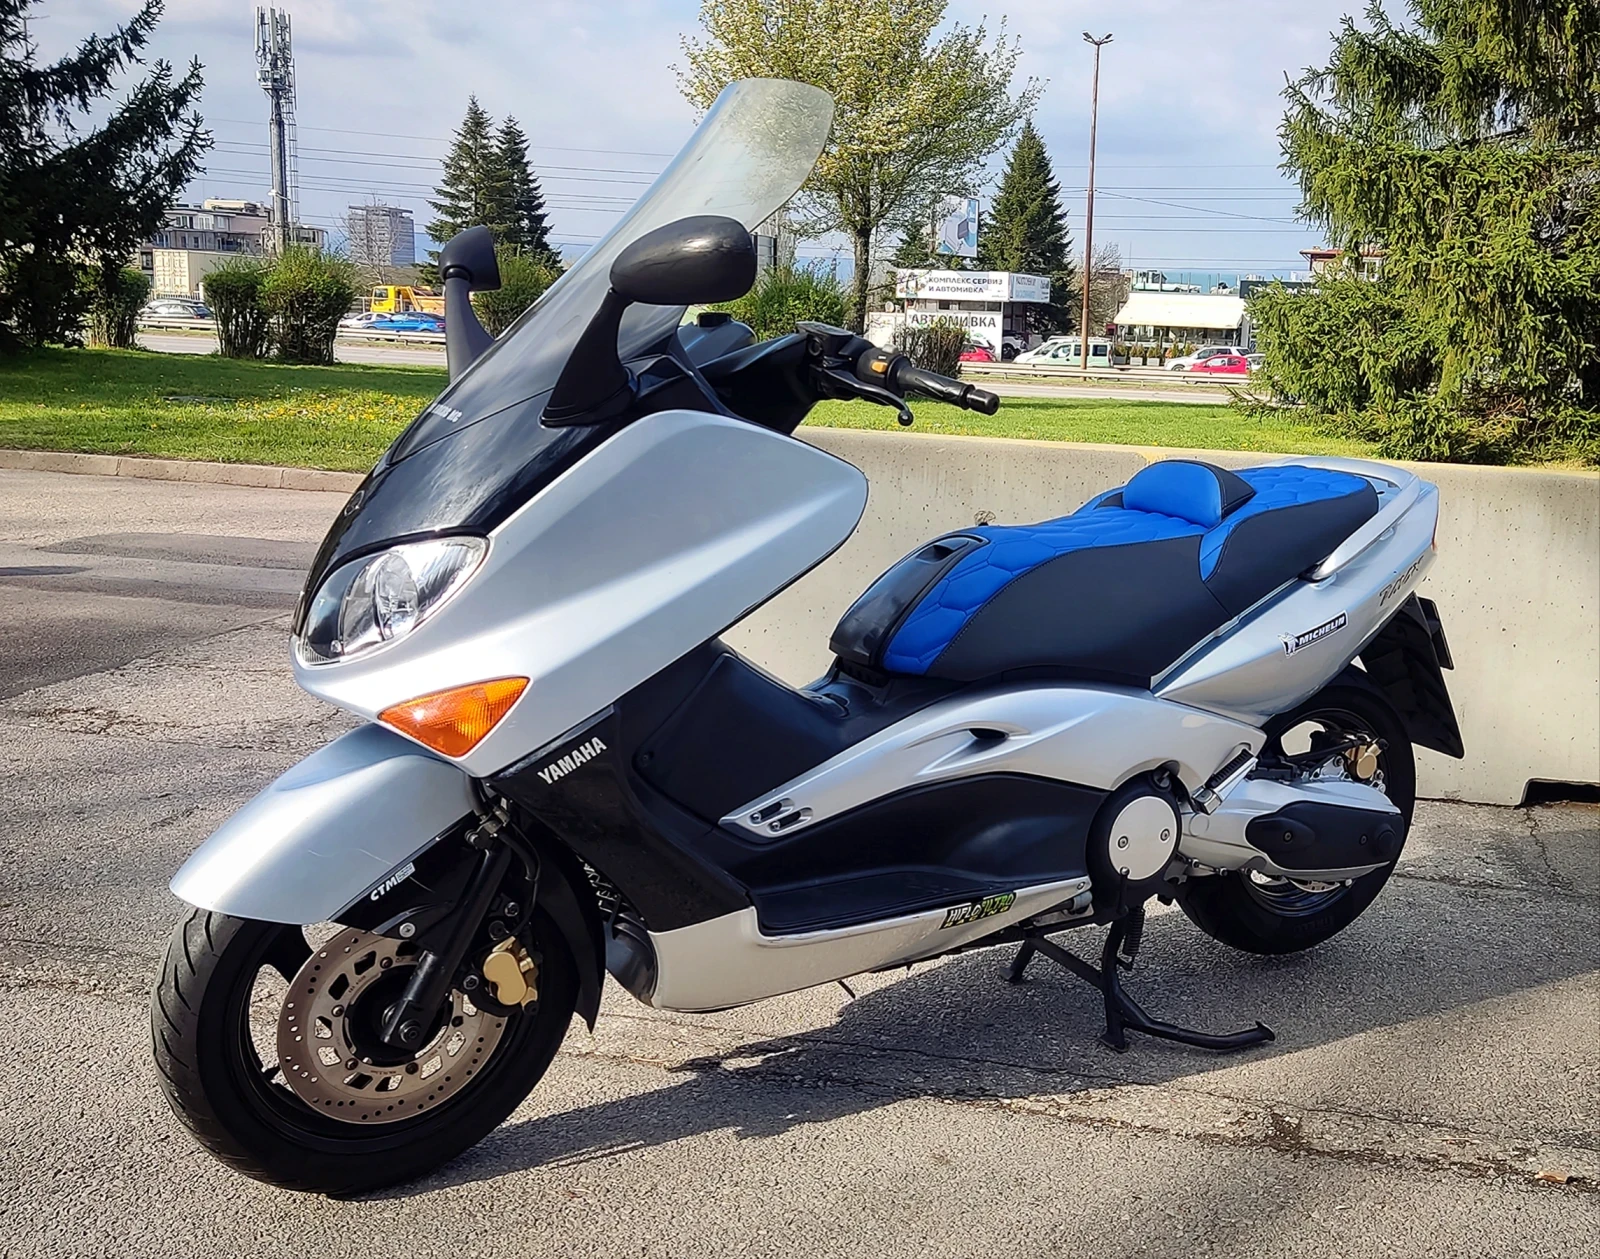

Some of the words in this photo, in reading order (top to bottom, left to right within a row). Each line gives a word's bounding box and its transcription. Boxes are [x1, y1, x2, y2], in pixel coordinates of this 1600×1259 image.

[935, 286, 984, 294] АВТОМИВКА
[911, 314, 996, 328] АВТОМИВКА
[1299, 616, 1346, 646] MICHELIN
[537, 736, 608, 785] YAMAHA
